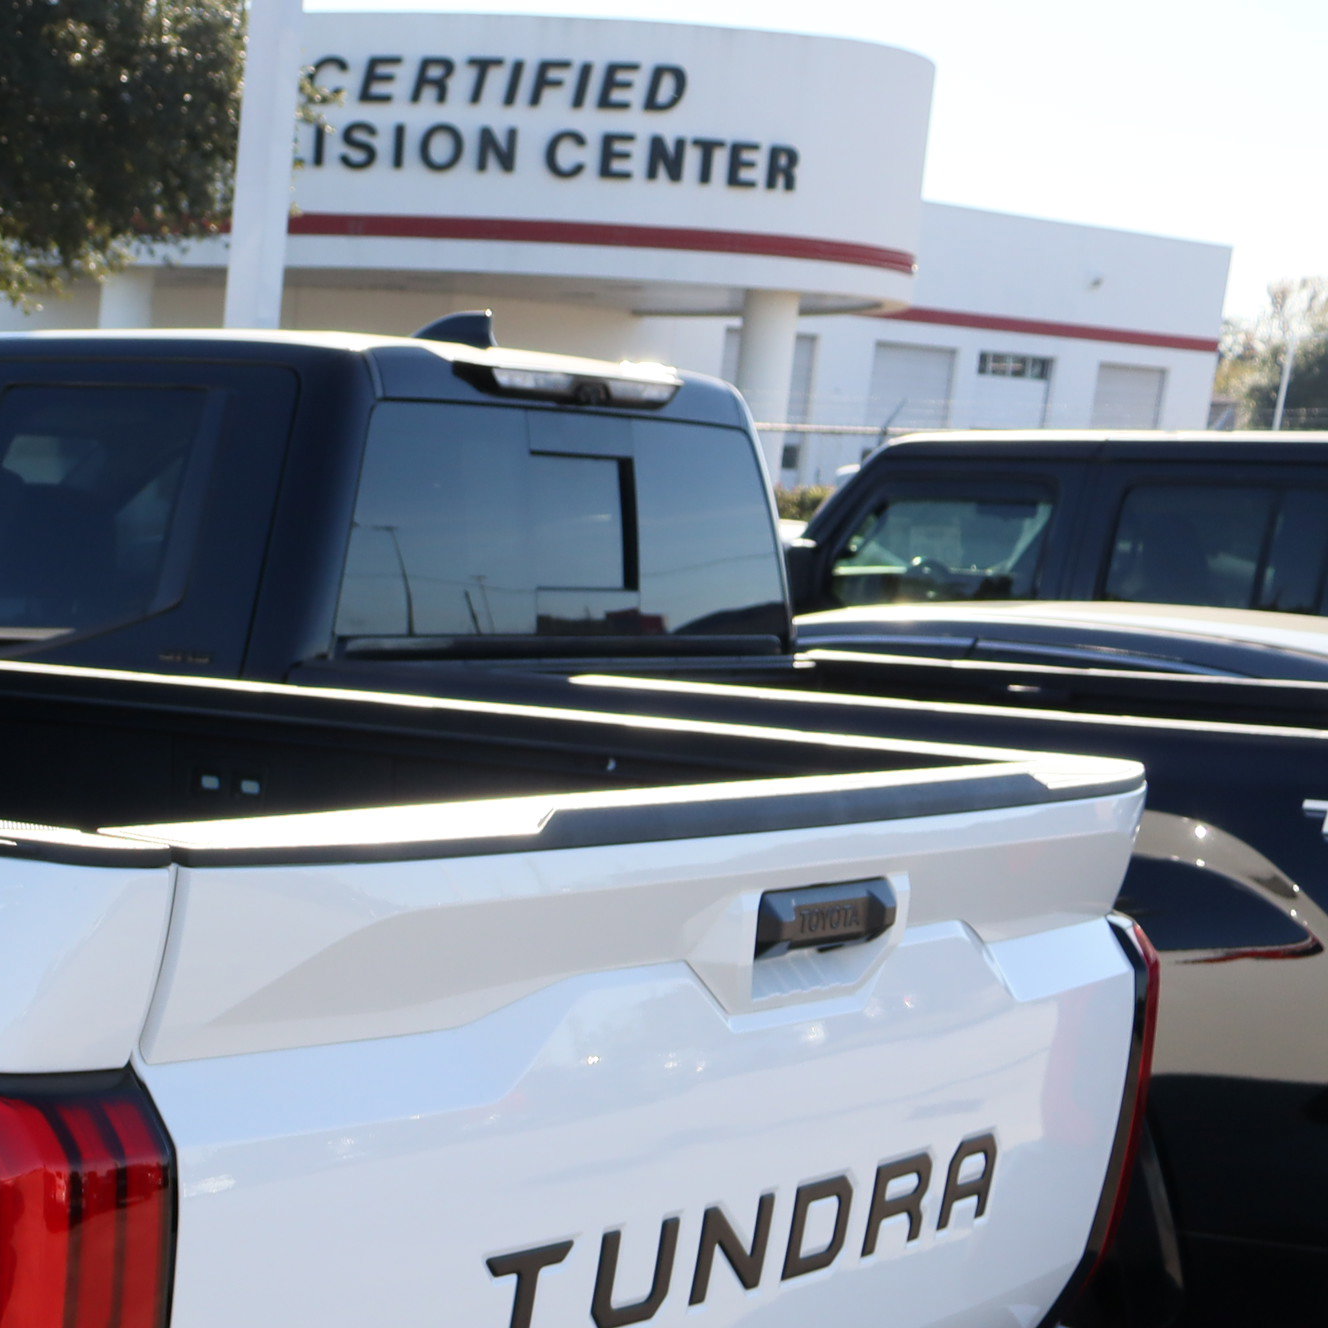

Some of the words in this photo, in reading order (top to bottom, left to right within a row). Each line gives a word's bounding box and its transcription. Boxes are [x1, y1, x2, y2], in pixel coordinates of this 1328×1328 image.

[301, 54, 688, 113] CERTIFIED
[295, 120, 518, 174] ISION
[545, 129, 801, 193] CENTER
[798, 903, 861, 934] TOYOTA
